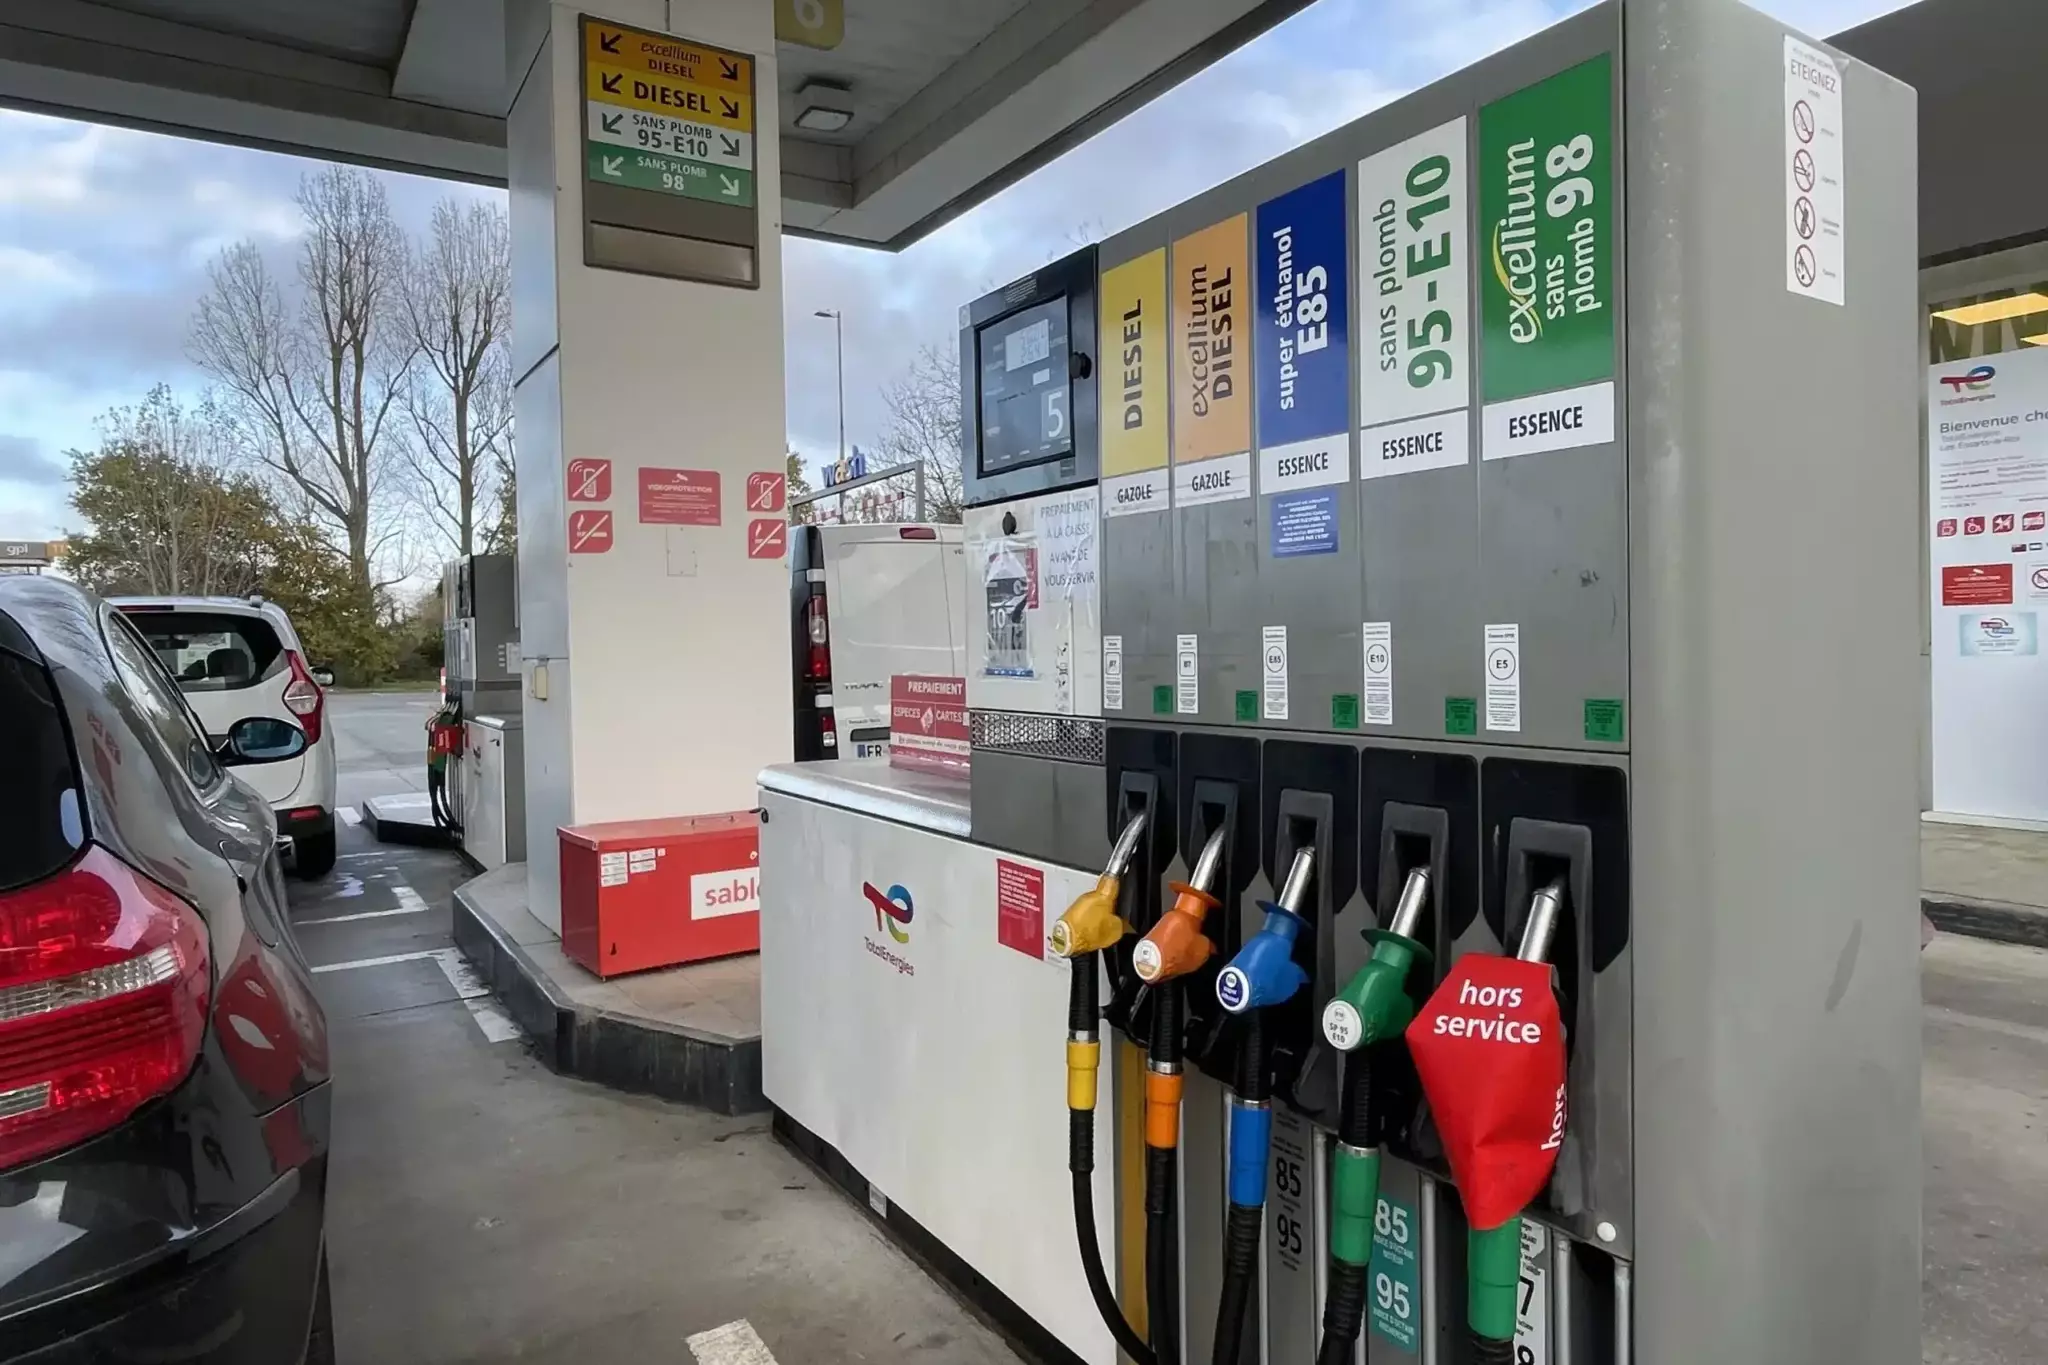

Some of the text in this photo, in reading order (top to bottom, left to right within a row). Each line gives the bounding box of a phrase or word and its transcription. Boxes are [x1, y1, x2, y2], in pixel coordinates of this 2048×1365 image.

[641, 40, 701, 65] excellium
[648, 58, 695, 79] DIESEL
[1790, 58, 1836, 94] ETEIGNEZ
[634, 81, 711, 114] DIESEL
[632, 113, 713, 139] SANS PLOMB
[637, 129, 708, 158] 95-E10
[637, 156, 707, 178] SANS PLOMB
[1545, 133, 1594, 218] 98
[662, 173, 684, 191] 98
[1500, 137, 1537, 344] excellium
[1405, 154, 1453, 389] 95-E10
[1567, 217, 1602, 314] plomb
[1372, 198, 1403, 372] sans plomb
[1545, 254, 1565, 320] sans
[1272, 226, 1298, 410] super éthanol
[1296, 265, 1328, 355] E85
[1187, 263, 1209, 417] excellium
[1211, 267, 1233, 400] DIESEL
[1123, 298, 1143, 430] DIESEL
[1048, 391, 1064, 438] 5
[1509, 405, 1584, 439] ESSENCE
[1940, 415, 2019, 433] Bienvenue
[1382, 431, 1443, 460] ESSENCE
[1278, 452, 1329, 477] ESSENCE
[1117, 484, 1152, 504] GAZOLE
[1191, 470, 1231, 492] GAZOLE
[1040, 498, 1095, 518] PREPAIEMENT
[6, 543, 29, 556] gpl
[1078, 548, 1088, 562] DE
[1044, 573, 1066, 587] VOUS
[1268, 655, 1282, 664] E85
[1370, 654, 1385, 663] E10
[1496, 659, 1508, 669] E5
[908, 681, 963, 695] PREPAIEMENT
[893, 706, 962, 723] ESPECES CARTES
[864, 936, 914, 976] TotalEnergies
[1459, 979, 1523, 1008] hors
[1329, 1022, 1338, 1031] SP
[1332, 1032, 1346, 1043] E10
[1433, 1014, 1541, 1043] service
[1541, 1083, 1568, 1151] hors
[1276, 1157, 1302, 1198] 85
[1277, 1214, 1302, 1255] 95
[1375, 1199, 1408, 1244] 85
[1376, 1272, 1410, 1319] 95
